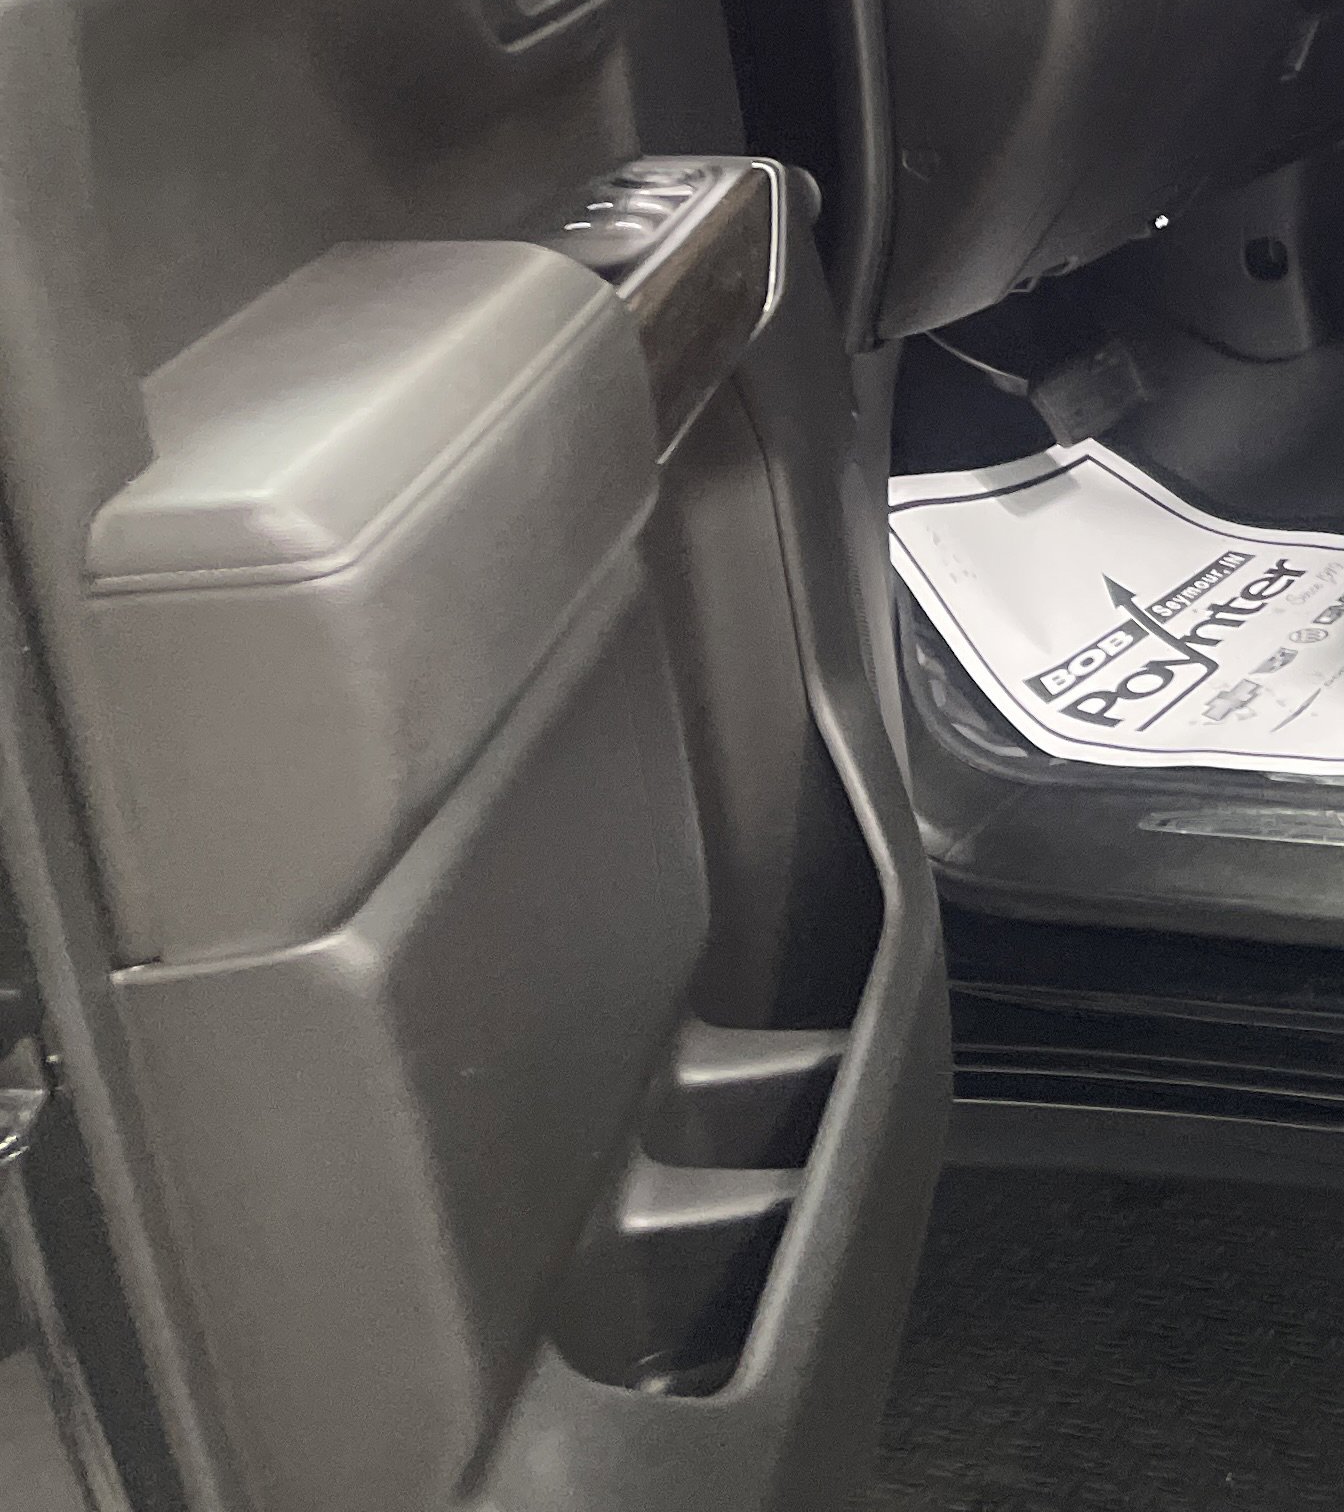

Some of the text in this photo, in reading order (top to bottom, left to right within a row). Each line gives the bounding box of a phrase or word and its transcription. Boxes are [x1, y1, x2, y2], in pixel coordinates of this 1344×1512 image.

[1218, 552, 1246, 573] IN
[1039, 630, 1135, 696] BOB
[1058, 558, 1307, 731] Poynter
